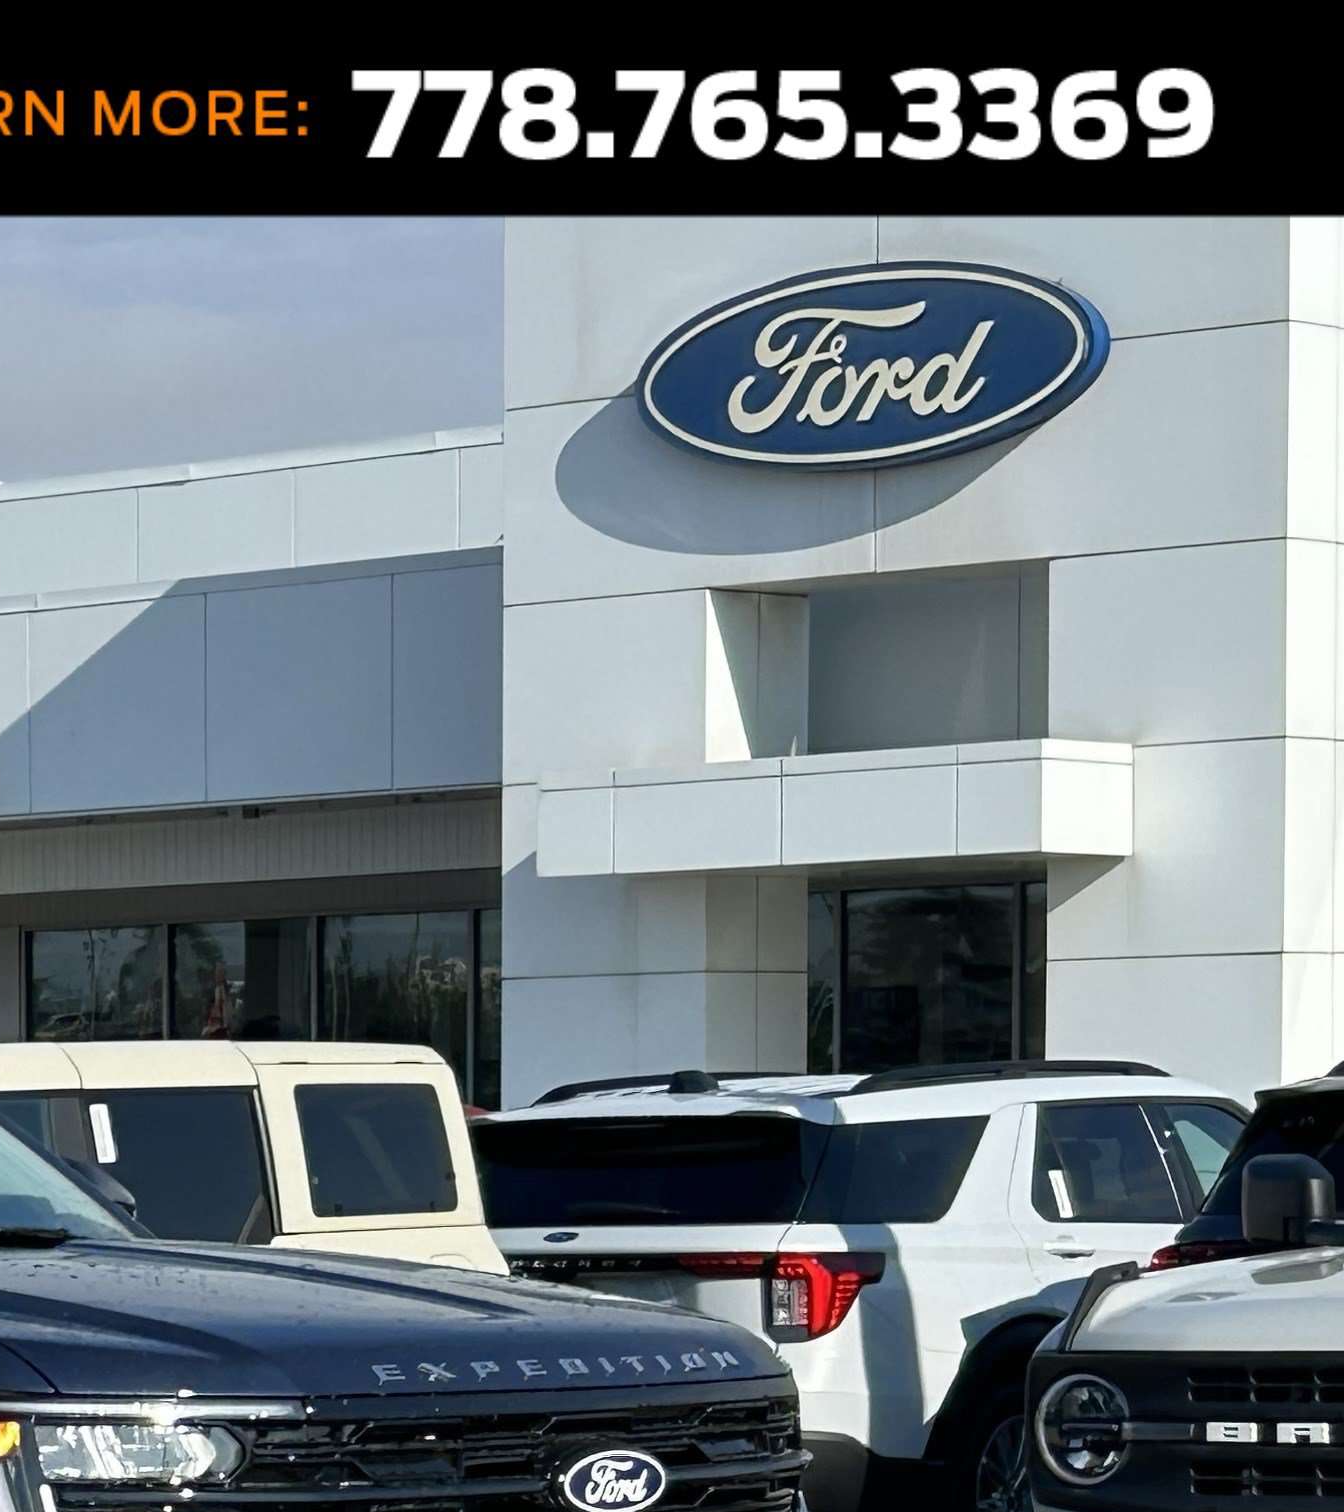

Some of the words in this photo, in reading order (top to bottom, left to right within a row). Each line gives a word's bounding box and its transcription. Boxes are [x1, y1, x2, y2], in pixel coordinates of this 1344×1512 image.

[726, 300, 996, 434] Ford
[371, 1347, 740, 1386] EXPEDITION
[584, 1459, 650, 1504] Ford
